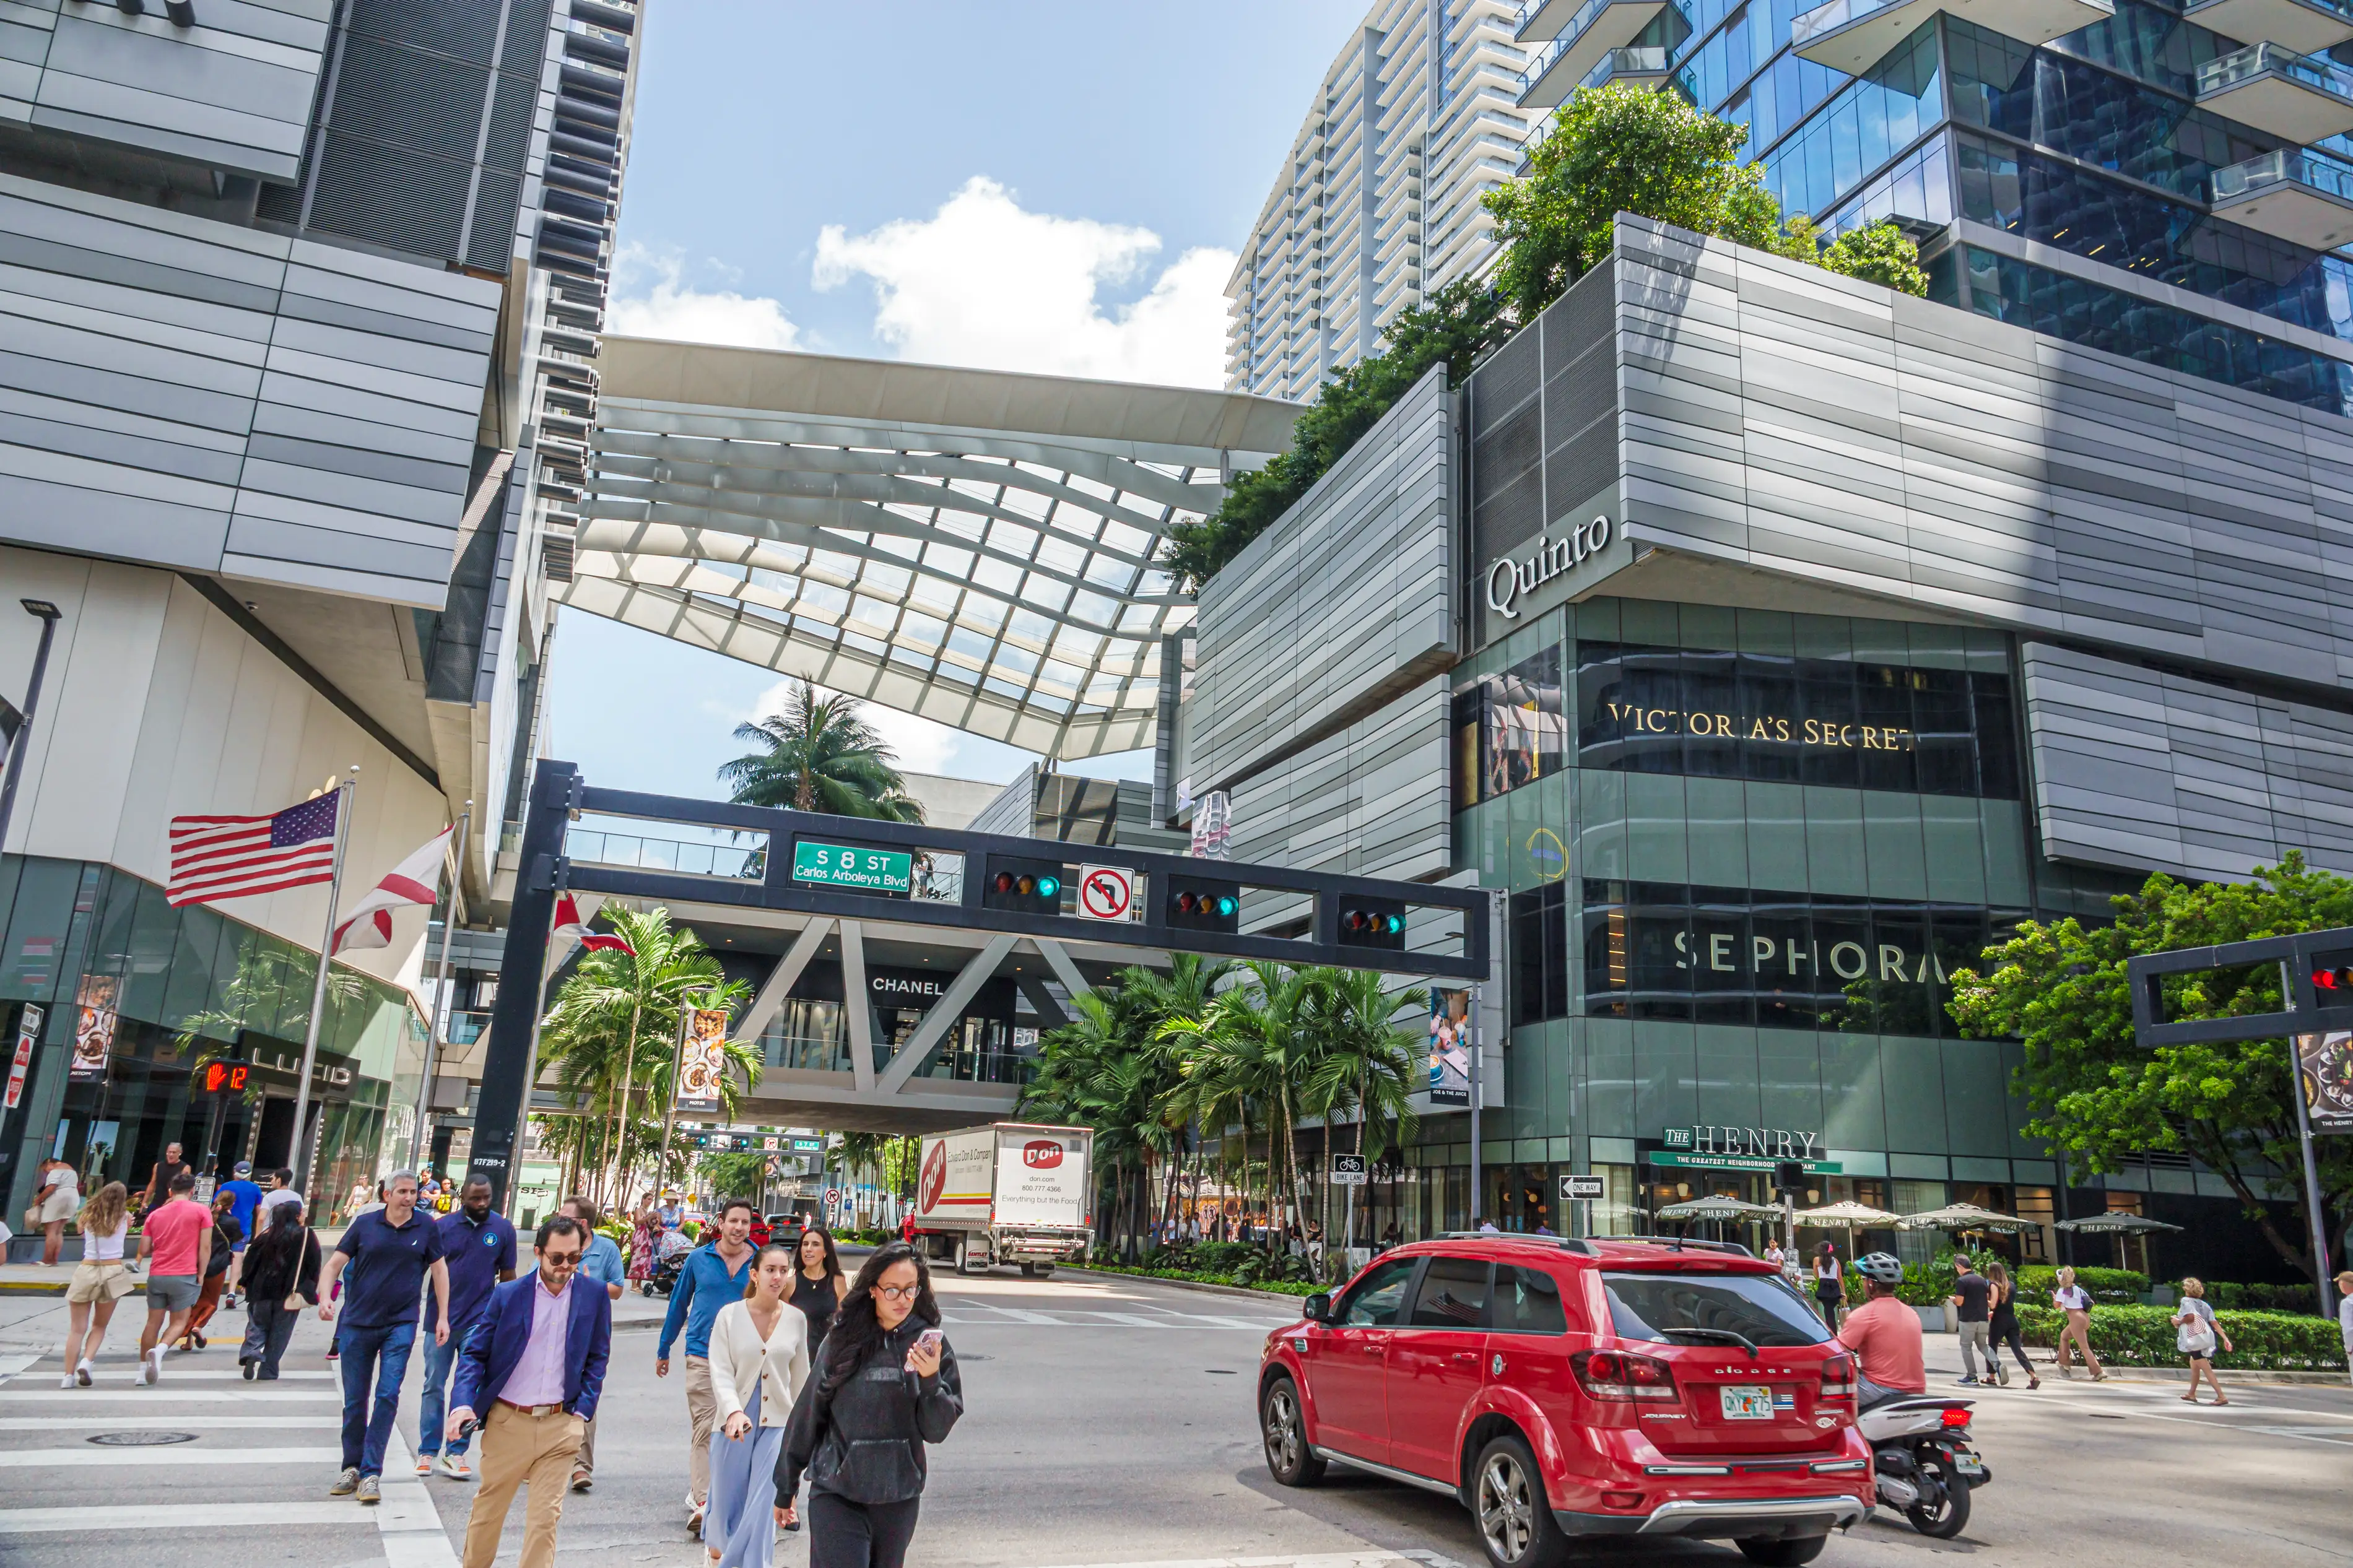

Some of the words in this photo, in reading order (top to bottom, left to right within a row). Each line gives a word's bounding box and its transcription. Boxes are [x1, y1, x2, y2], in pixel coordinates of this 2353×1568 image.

[1487, 515, 1609, 618] Quinto
[1608, 703, 1789, 742] VICORA'S
[816, 850, 829, 865] S
[840, 851, 855, 869] 8
[867, 855, 890, 871] ST
[796, 865, 828, 878] Carlos
[832, 868, 881, 886] Arboleya
[884, 874, 908, 888] Blvd
[1674, 931, 1947, 984] SEPHORA
[872, 977, 944, 995] CHANEL
[230, 1067, 248, 1089] 12
[1666, 1128, 1689, 1143] THE
[1692, 1125, 1818, 1159] HENRY
[970, 1150, 973, 1161] &
[974, 1148, 993, 1162] Company
[1027, 1145, 1059, 1164] Don
[1692, 1157, 1726, 1165] GREATEST
[1728, 1159, 1775, 1168] NEIGHBORHOOD
[923, 1144, 944, 1210] Don
[1573, 1184, 1584, 1192] ONE
[1586, 1184, 1597, 1192] WAY
[1002, 1195, 1035, 1204] Everything
[1665, 1208, 1694, 1216] HENRY
[1749, 1211, 1777, 1221] HENRY
[1814, 1218, 1848, 1226] HENRY
